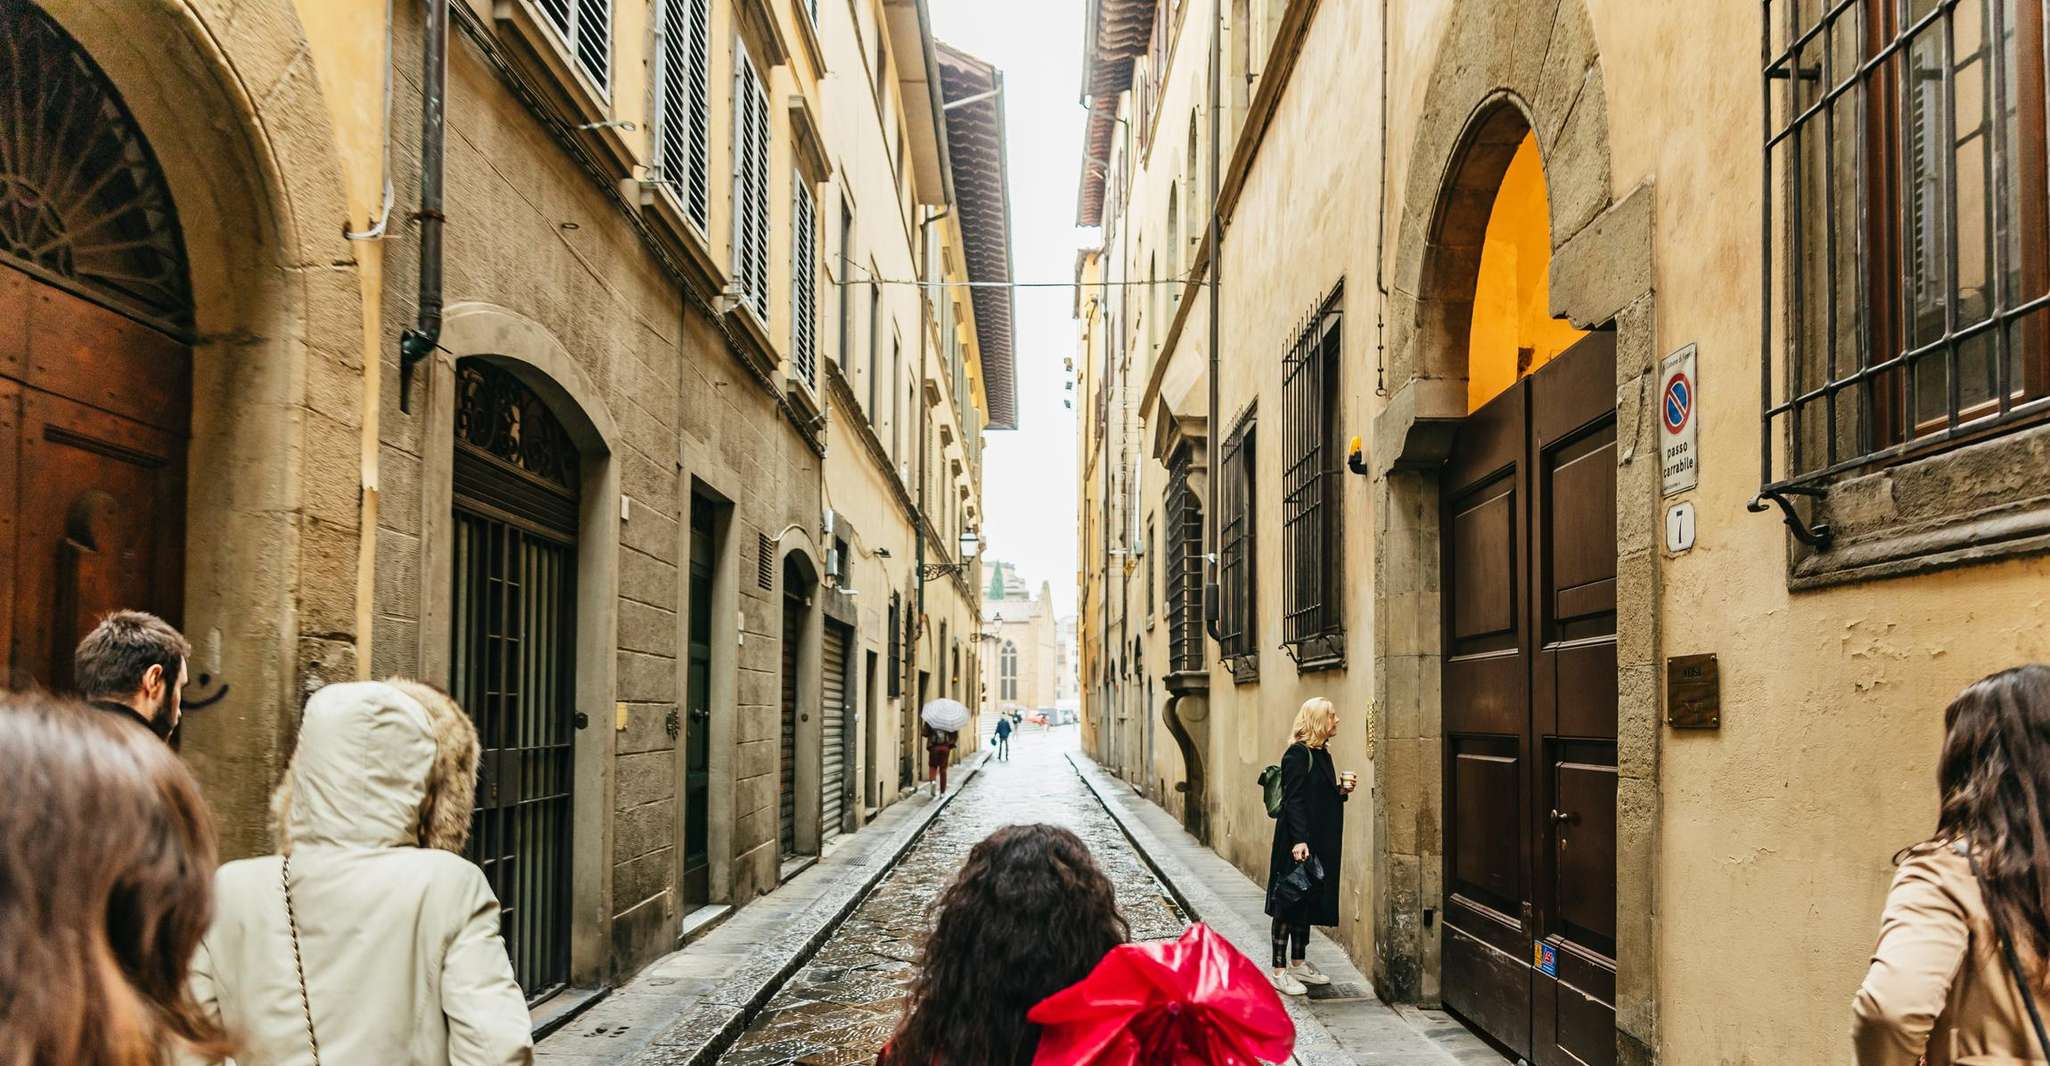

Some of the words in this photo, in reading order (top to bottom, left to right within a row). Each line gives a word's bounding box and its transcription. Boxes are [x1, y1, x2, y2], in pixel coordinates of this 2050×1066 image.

[1667, 441, 1688, 461] passo
[1663, 457, 1693, 478] carrabile
[1676, 510, 1683, 544] 7
